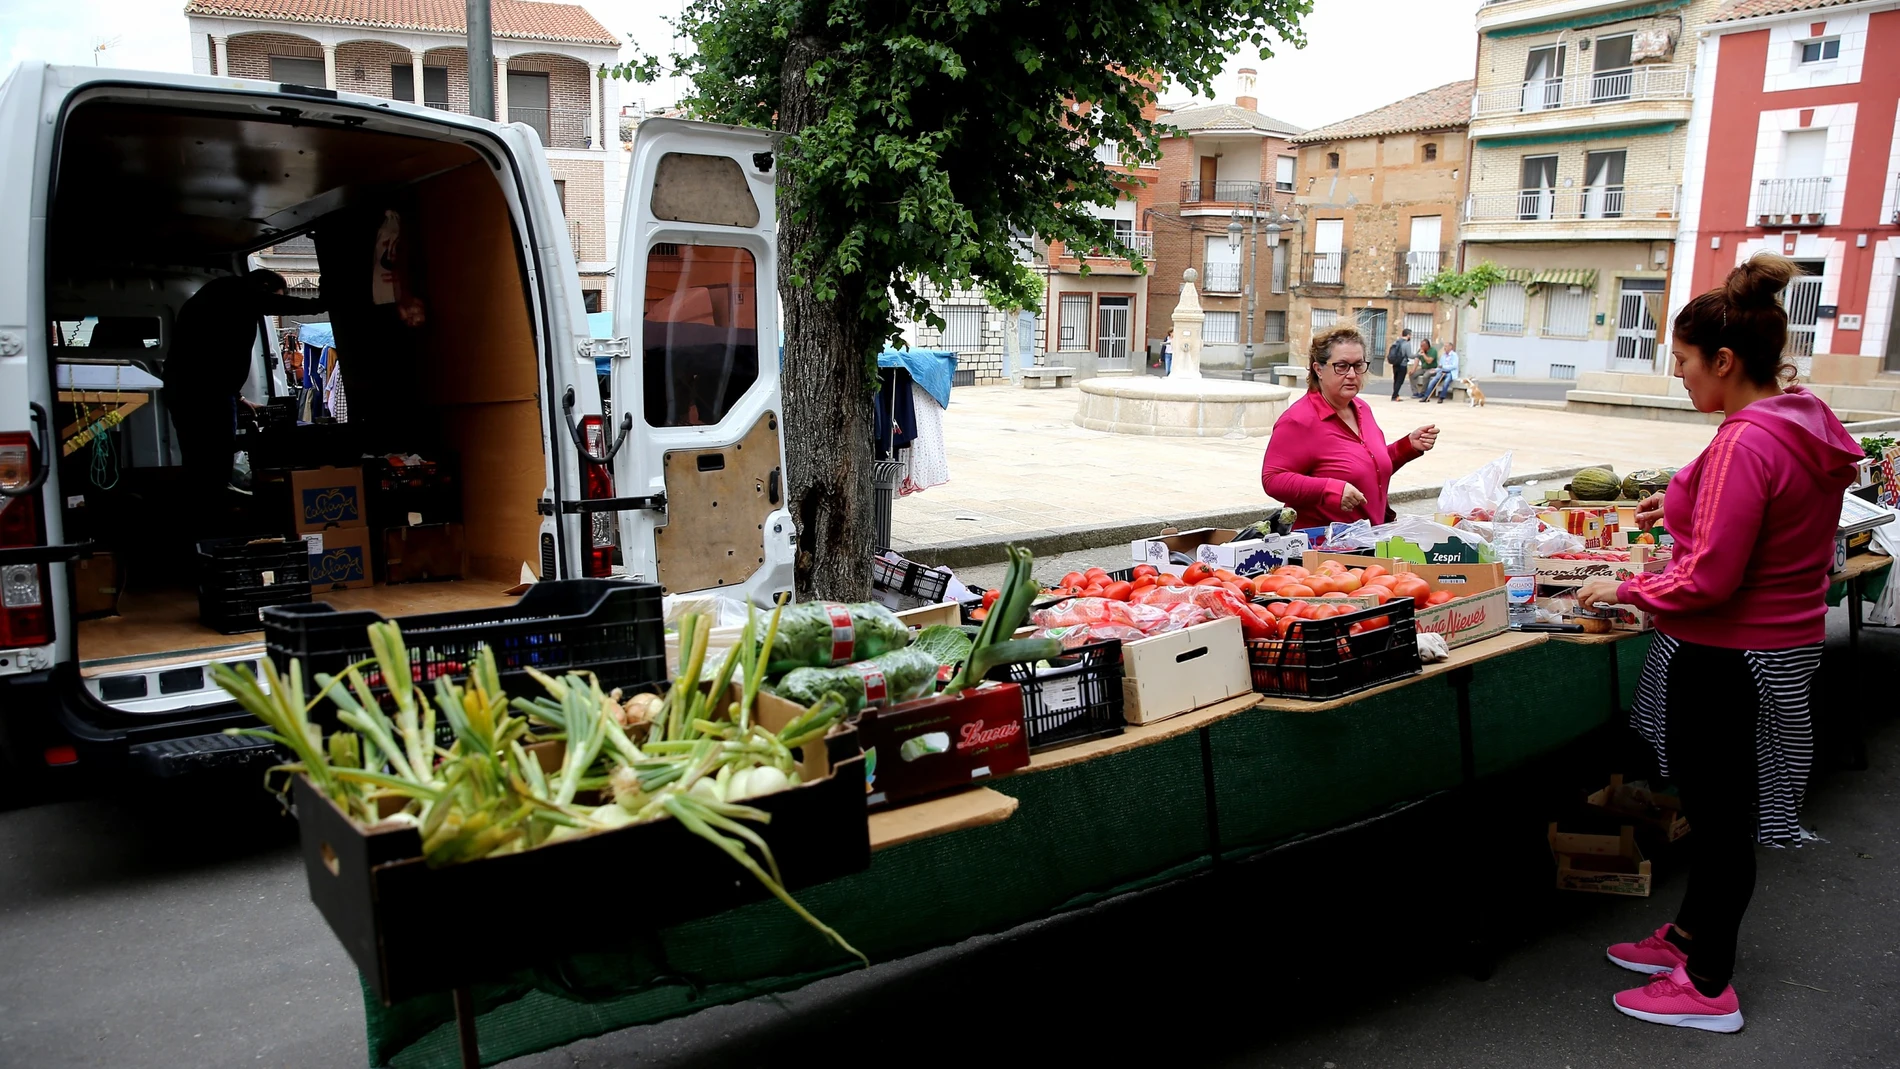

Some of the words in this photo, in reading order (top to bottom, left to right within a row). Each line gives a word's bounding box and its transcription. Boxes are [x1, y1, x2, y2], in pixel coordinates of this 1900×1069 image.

[1432, 552, 1462, 564] Zespri
[1444, 605, 1486, 641] Nieves
[956, 719, 1020, 749] Lucas
